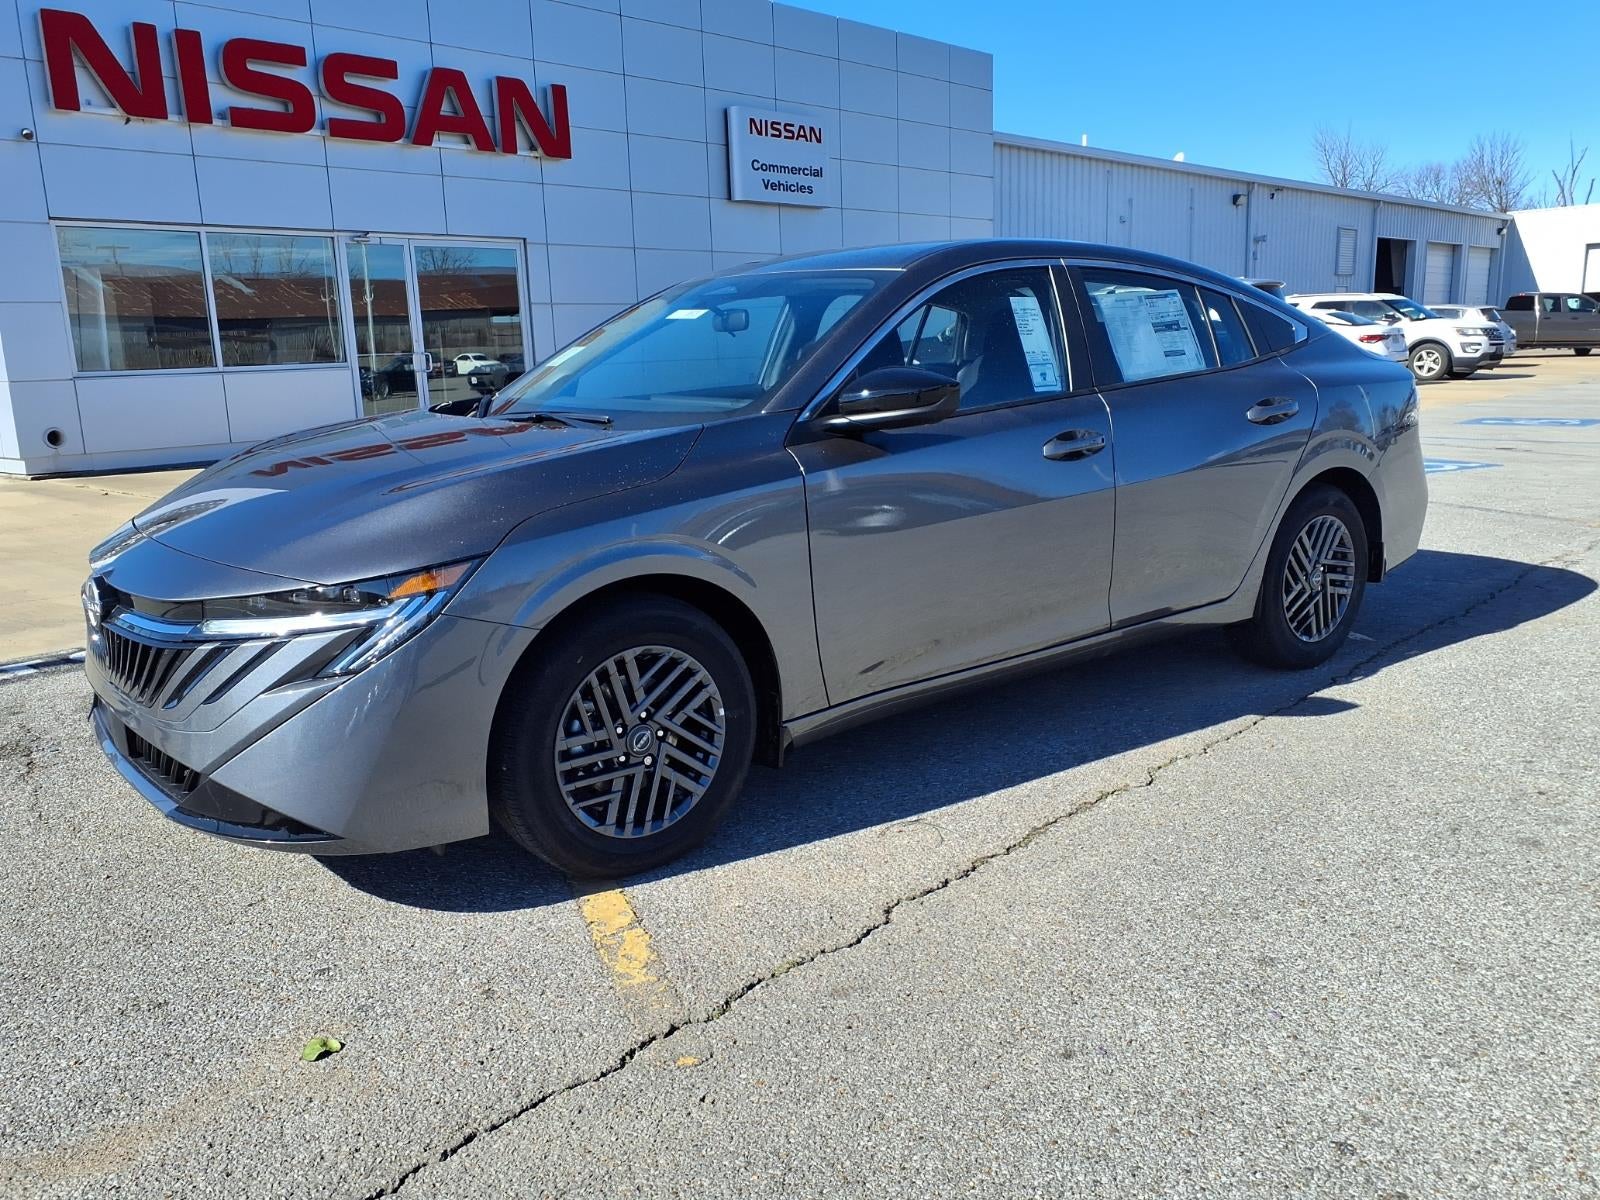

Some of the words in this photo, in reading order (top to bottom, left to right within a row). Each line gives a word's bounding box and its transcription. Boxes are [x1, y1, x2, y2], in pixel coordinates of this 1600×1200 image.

[39, 8, 572, 160] NISSAN
[749, 117, 822, 144] NISSAN
[751, 159, 823, 178] Commercial
[762, 178, 814, 195] Vehicles
